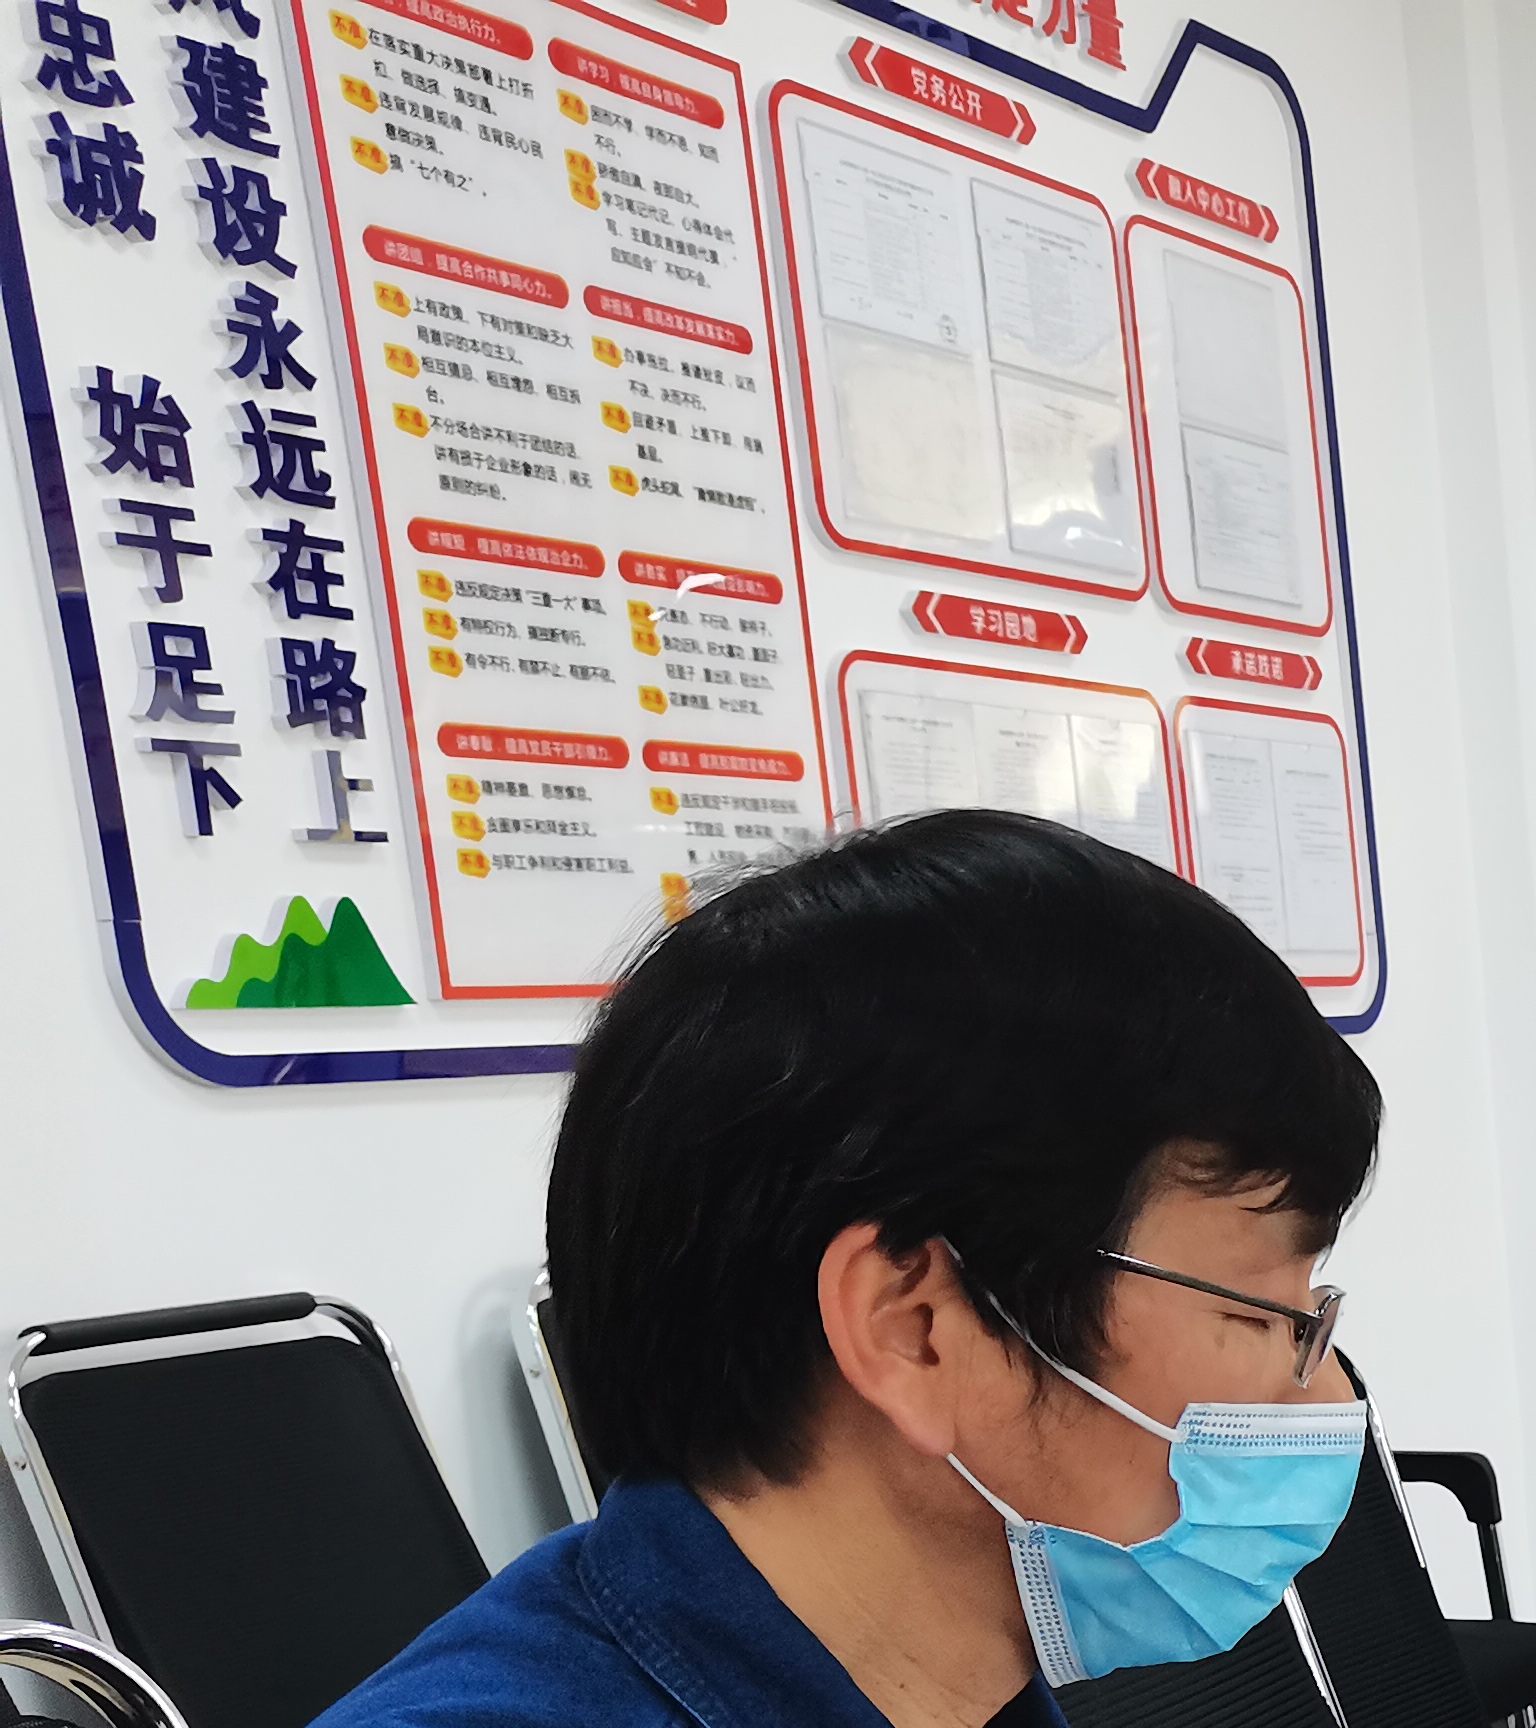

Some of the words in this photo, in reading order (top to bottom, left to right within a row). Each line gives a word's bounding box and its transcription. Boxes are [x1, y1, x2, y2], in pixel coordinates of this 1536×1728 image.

[911, 68, 983, 120] 党务公开
[87, 365, 243, 836] 始于足下
[968, 604, 1039, 644] 学习园地
